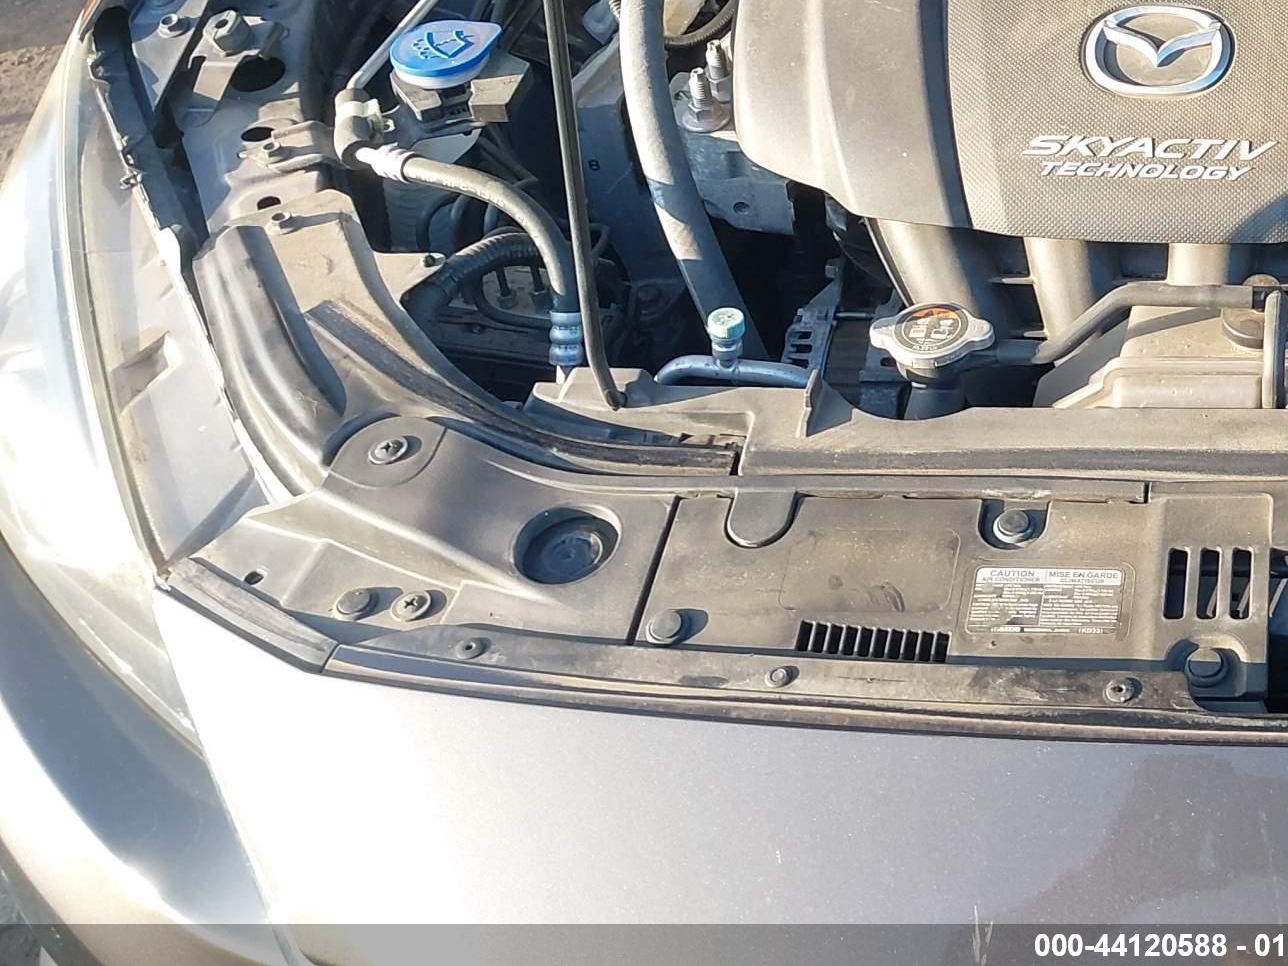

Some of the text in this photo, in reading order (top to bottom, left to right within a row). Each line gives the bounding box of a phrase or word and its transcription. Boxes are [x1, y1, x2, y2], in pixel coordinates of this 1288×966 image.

[1021, 135, 1279, 161] SKYACTIV
[1042, 161, 1254, 181] TECHNOLOGY
[990, 569, 1035, 577] CAUTION
[1048, 570, 1071, 578] MISE
[1073, 571, 1086, 579] EN
